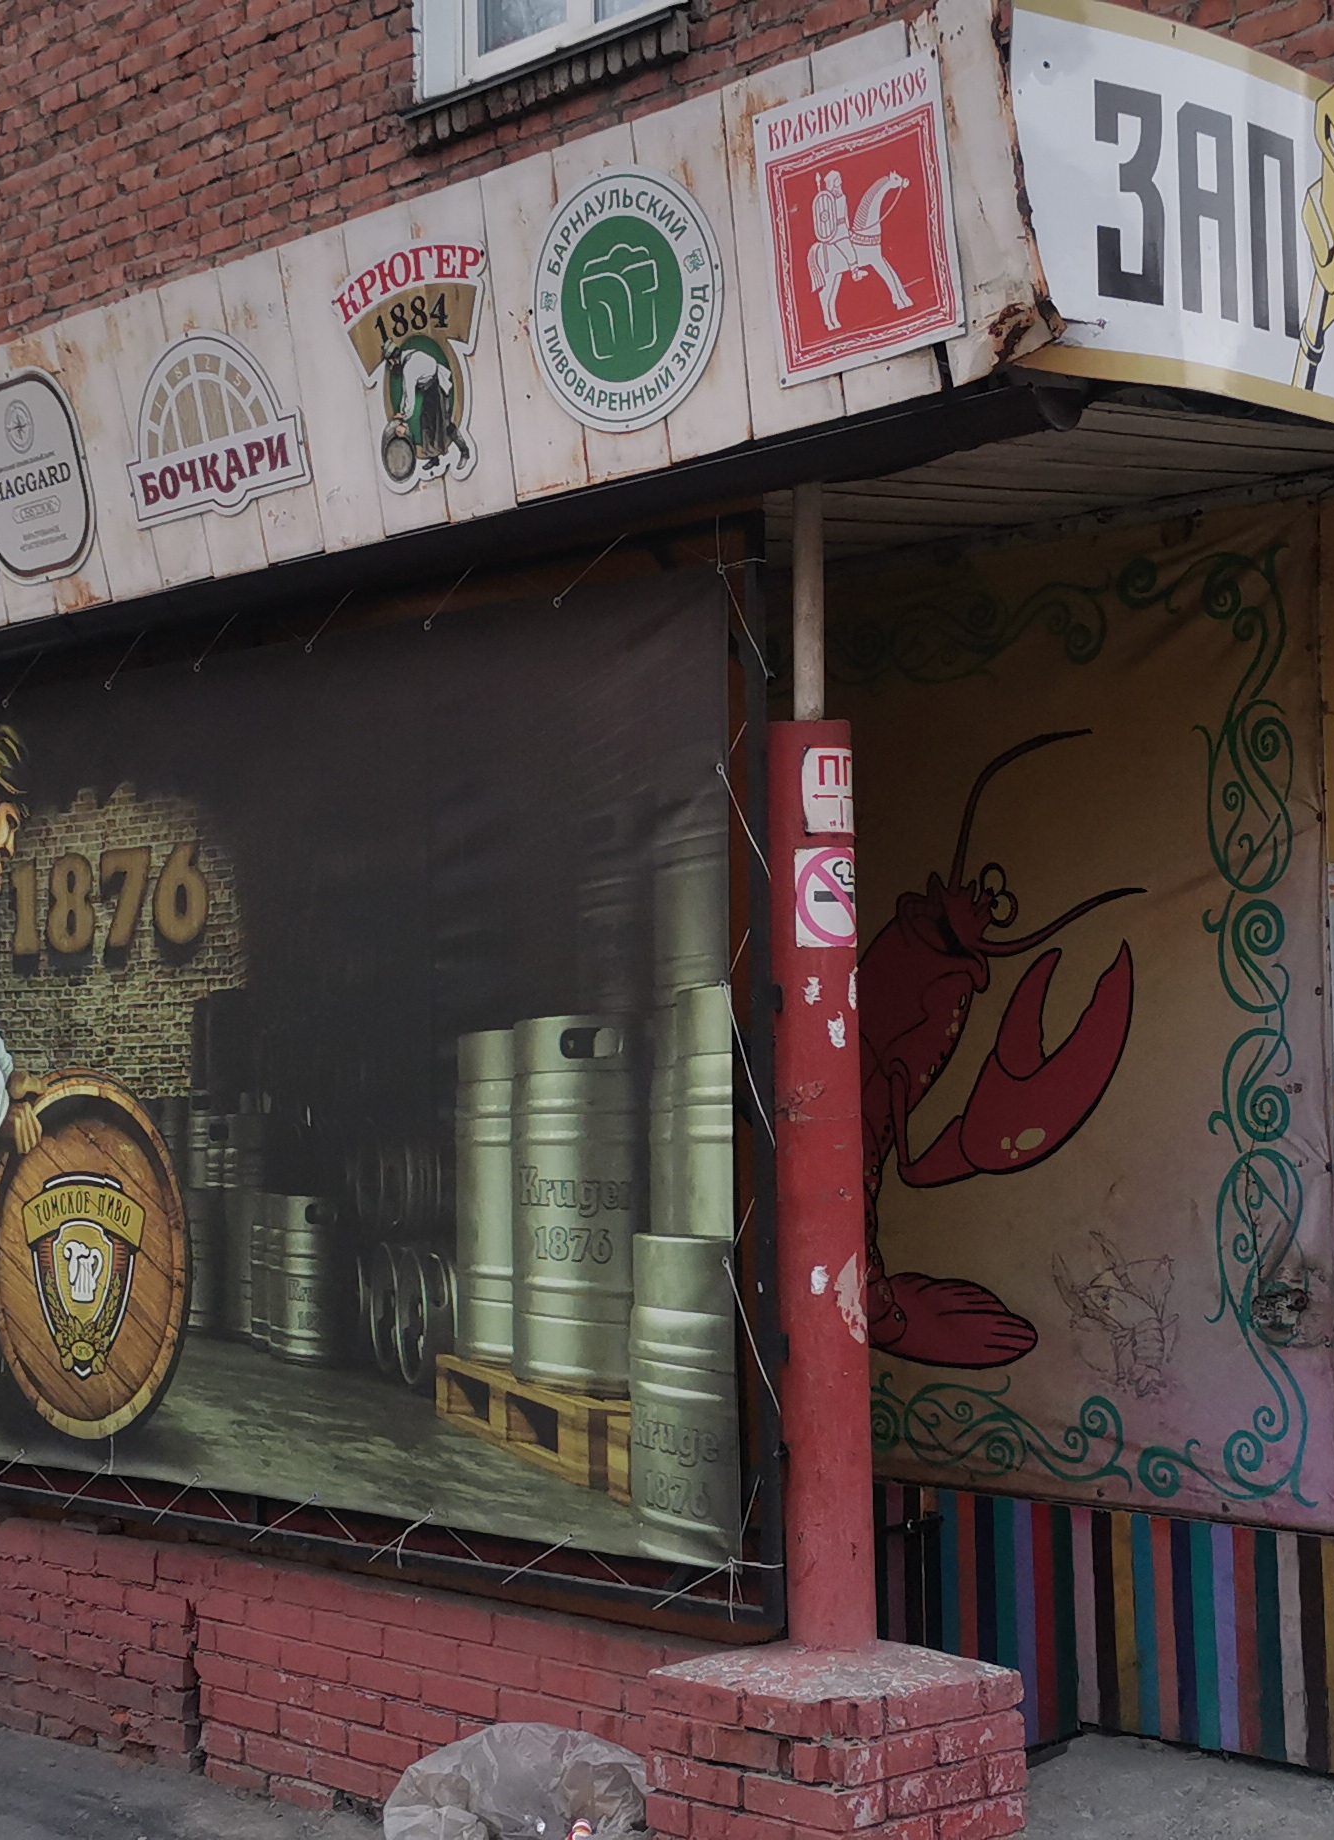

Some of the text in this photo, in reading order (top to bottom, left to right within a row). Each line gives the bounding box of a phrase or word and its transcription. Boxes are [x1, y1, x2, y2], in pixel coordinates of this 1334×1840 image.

[767, 66, 927, 152] КРАСНОГОРСКОЕ
[547, 187, 689, 277] БАРНАУЛЬСКИЙ
[335, 244, 481, 325] КРЮГЕР
[374, 292, 450, 350] 1884
[543, 283, 710, 412] ПИВОВАРЕННЫЙ ЗАВОД
[138, 432, 292, 507] БОЧКАРИ
[11, 843, 209, 956] 1876
[34, 1190, 131, 1228] ТОМСКОЕ ПИВО
[535, 1225, 613, 1265] 1876
